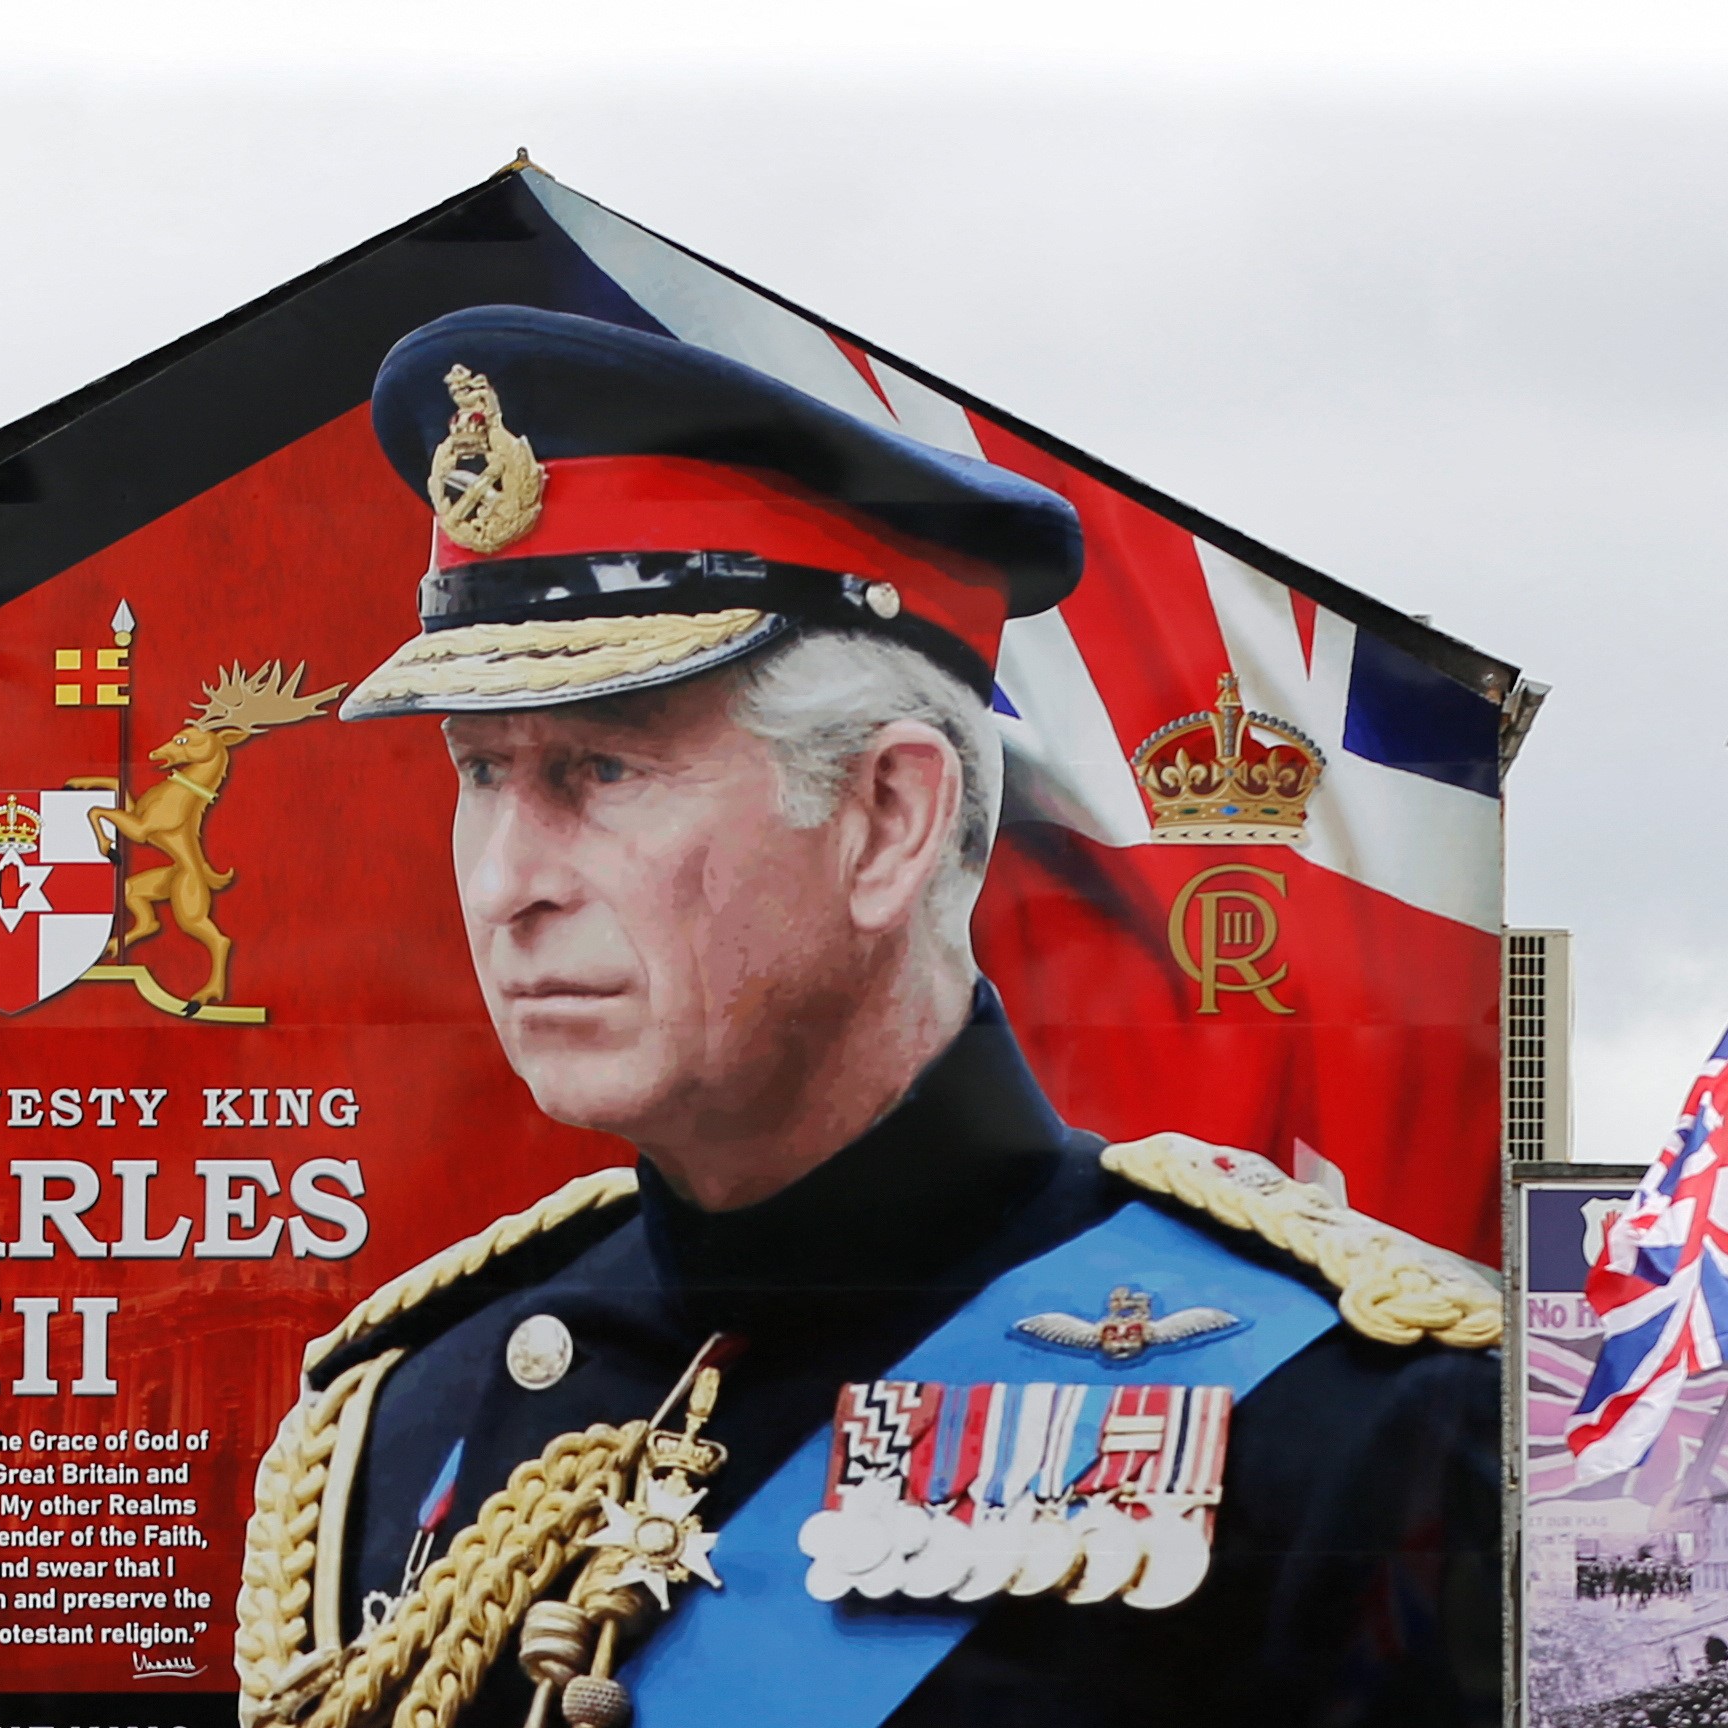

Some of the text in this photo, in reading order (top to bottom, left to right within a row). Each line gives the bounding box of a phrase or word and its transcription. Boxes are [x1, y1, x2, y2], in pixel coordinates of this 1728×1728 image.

[202, 1087, 360, 1127] KING
[29, 1429, 98, 1451] Grace
[104, 1429, 128, 1451] of
[134, 1429, 179, 1451] God
[185, 1429, 209, 1451] of
[62, 1462, 139, 1485] Britain
[146, 1462, 188, 1484] and
[0, 1494, 34, 1521] My
[39, 1494, 103, 1516] other
[109, 1493, 197, 1516] Realms
[70, 1525, 94, 1547] of
[99, 1524, 137, 1547] the
[144, 1524, 208, 1549] Faith,
[36, 1561, 109, 1578] swear
[114, 1556, 160, 1578] that
[167, 1555, 174, 1578] I
[13, 1587, 56, 1609] and
[63, 1592, 167, 1615] preserve
[173, 1587, 211, 1609] the
[100, 1621, 207, 1649] religion.”
